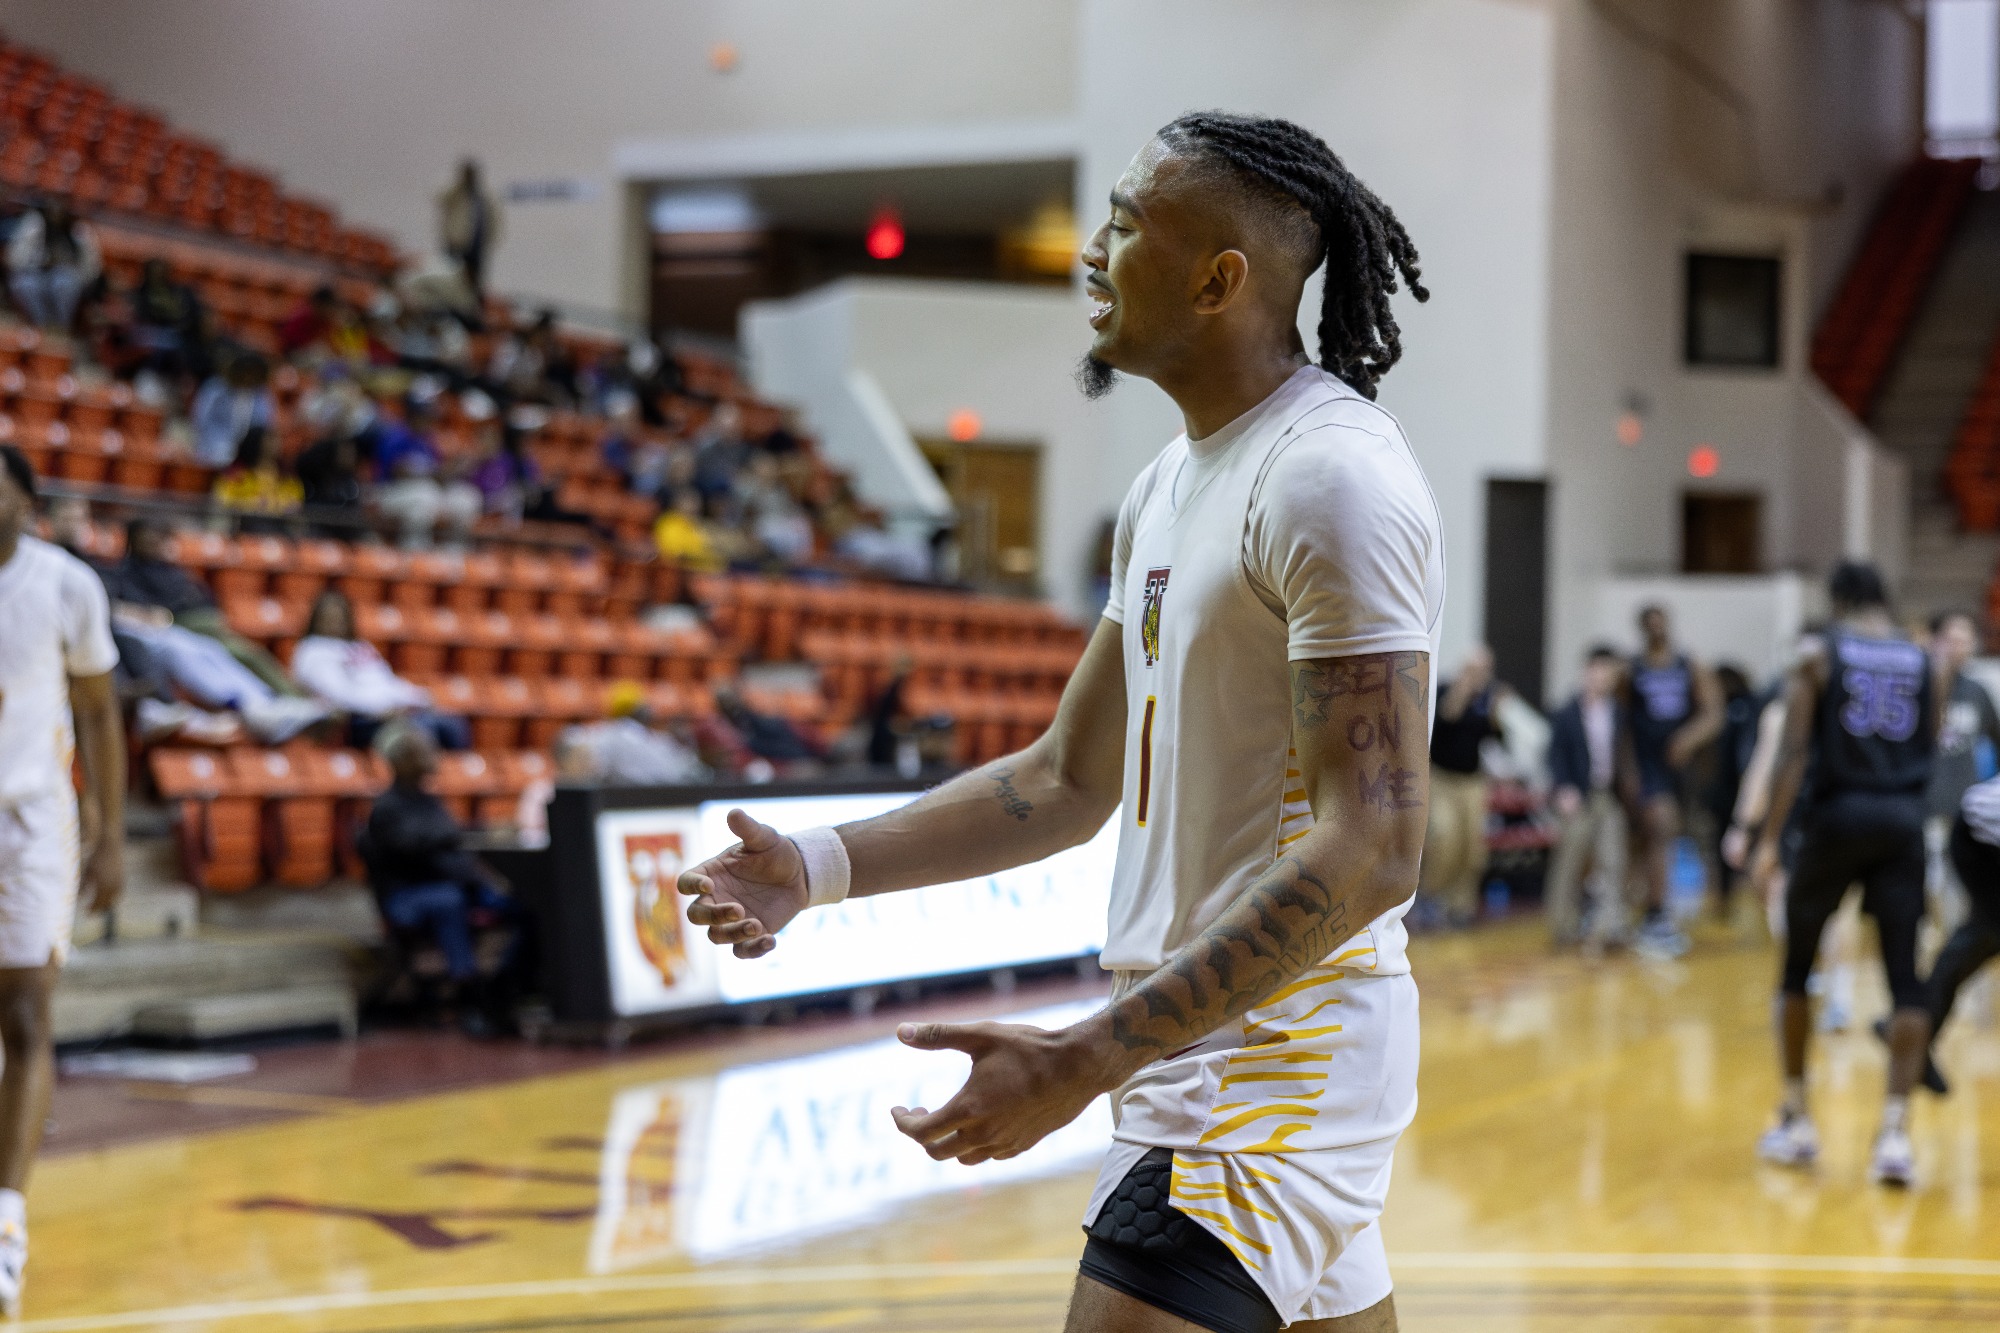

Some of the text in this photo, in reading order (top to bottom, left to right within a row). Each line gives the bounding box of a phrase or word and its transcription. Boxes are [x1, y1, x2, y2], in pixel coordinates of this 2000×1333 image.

[1321, 653, 1412, 708] BET
[1839, 668, 1920, 741] 35
[1347, 702, 1401, 752] ON
[1137, 695, 1157, 828] 1
[1358, 762, 1424, 815] ME
